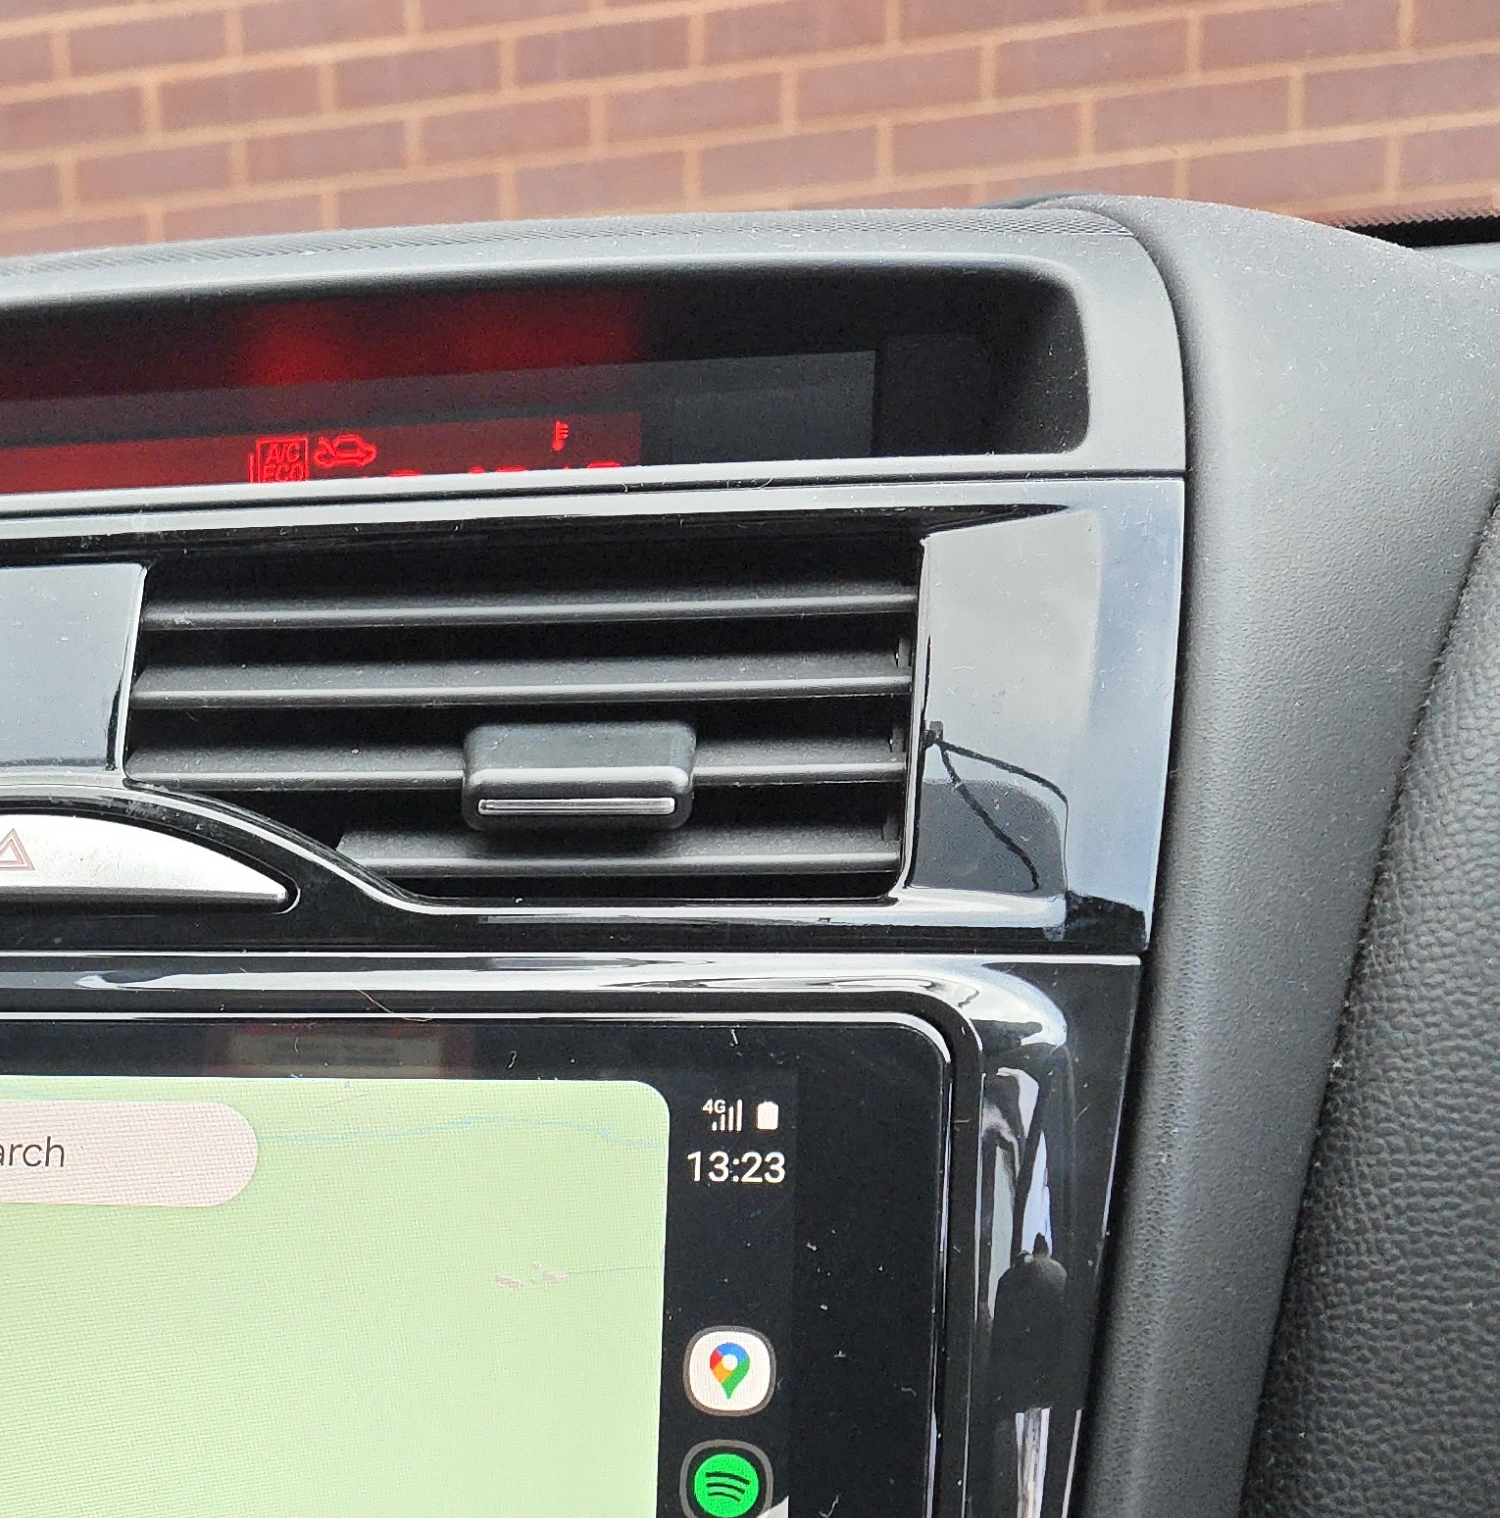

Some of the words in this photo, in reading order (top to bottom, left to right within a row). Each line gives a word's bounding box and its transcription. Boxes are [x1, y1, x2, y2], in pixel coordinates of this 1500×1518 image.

[266, 441, 301, 463] A/C
[701, 1098, 726, 1115] 4G
[687, 1150, 786, 1183] 13:23
